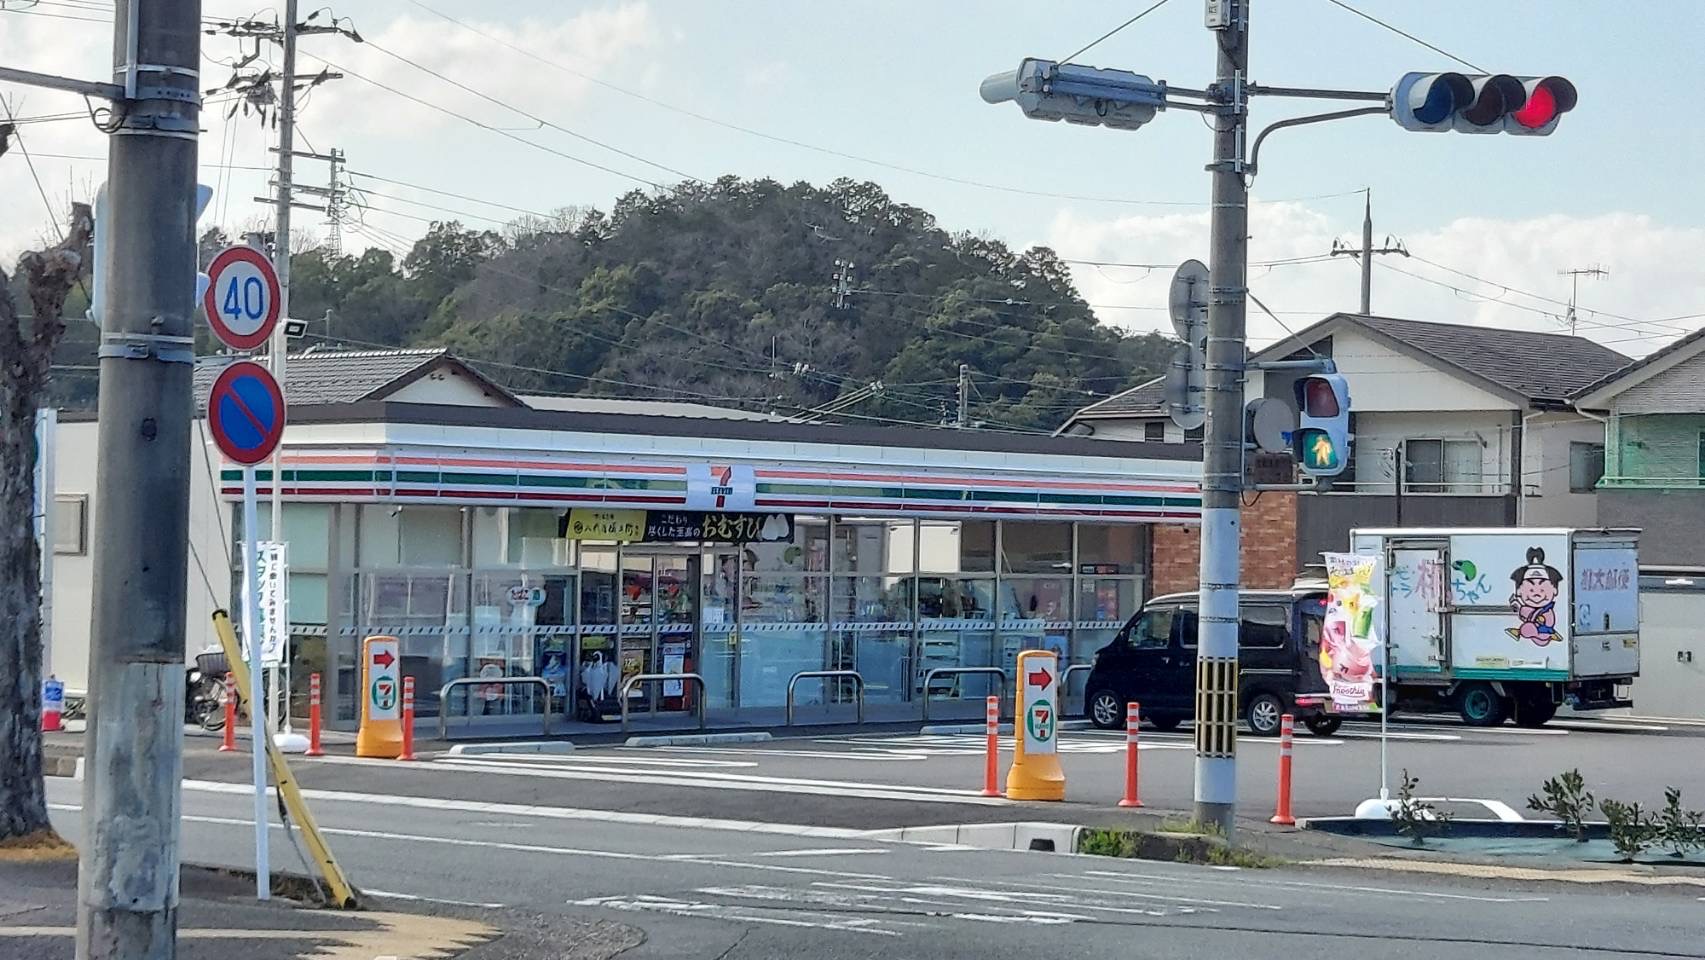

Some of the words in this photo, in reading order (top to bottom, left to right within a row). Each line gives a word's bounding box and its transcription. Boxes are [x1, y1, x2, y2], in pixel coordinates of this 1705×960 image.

[224, 276, 264, 320] 40
[710, 465, 732, 508] 7
[661, 514, 688, 525] こだわり
[702, 513, 763, 540] おむすび
[379, 684, 392, 707] 7
[1035, 710, 1049, 737] 7
